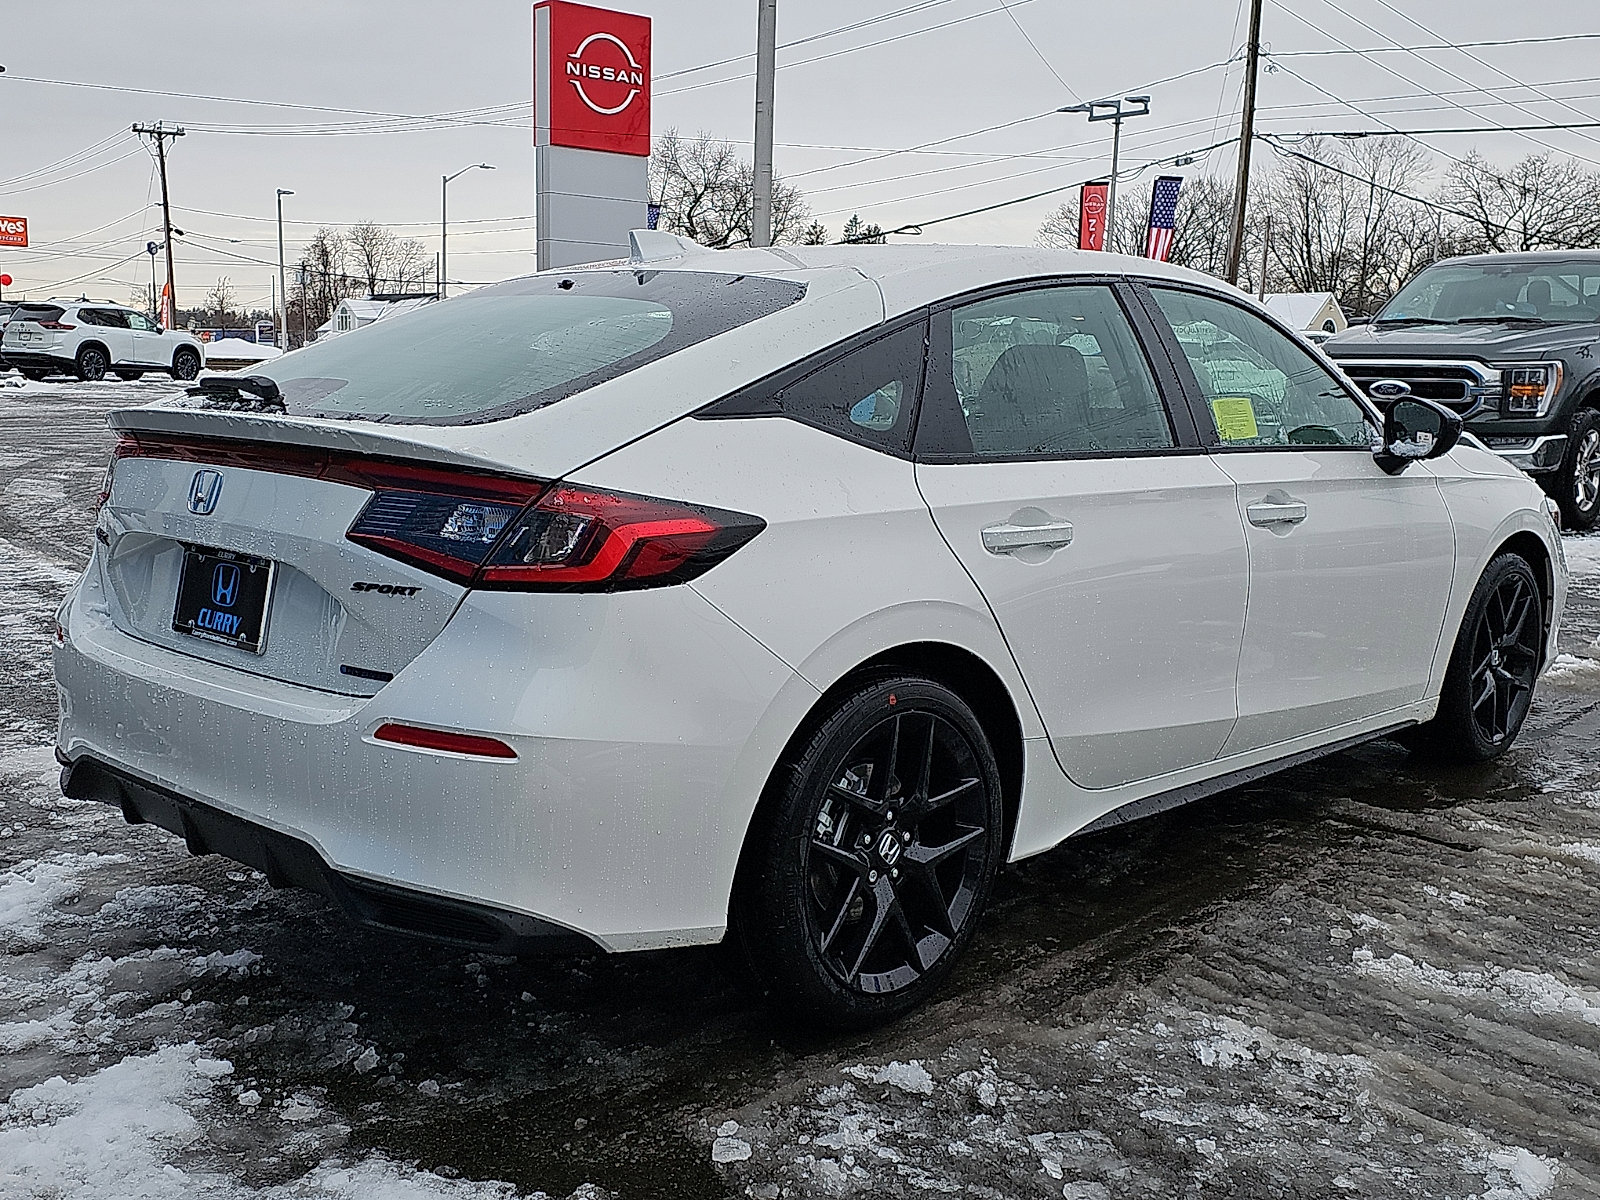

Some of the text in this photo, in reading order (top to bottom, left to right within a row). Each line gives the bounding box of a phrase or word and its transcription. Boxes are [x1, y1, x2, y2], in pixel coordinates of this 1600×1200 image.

[566, 61, 643, 86] NISSAN
[1378, 384, 1399, 395] Ford
[350, 581, 423, 597] SPORT
[197, 607, 243, 635] CURRY
